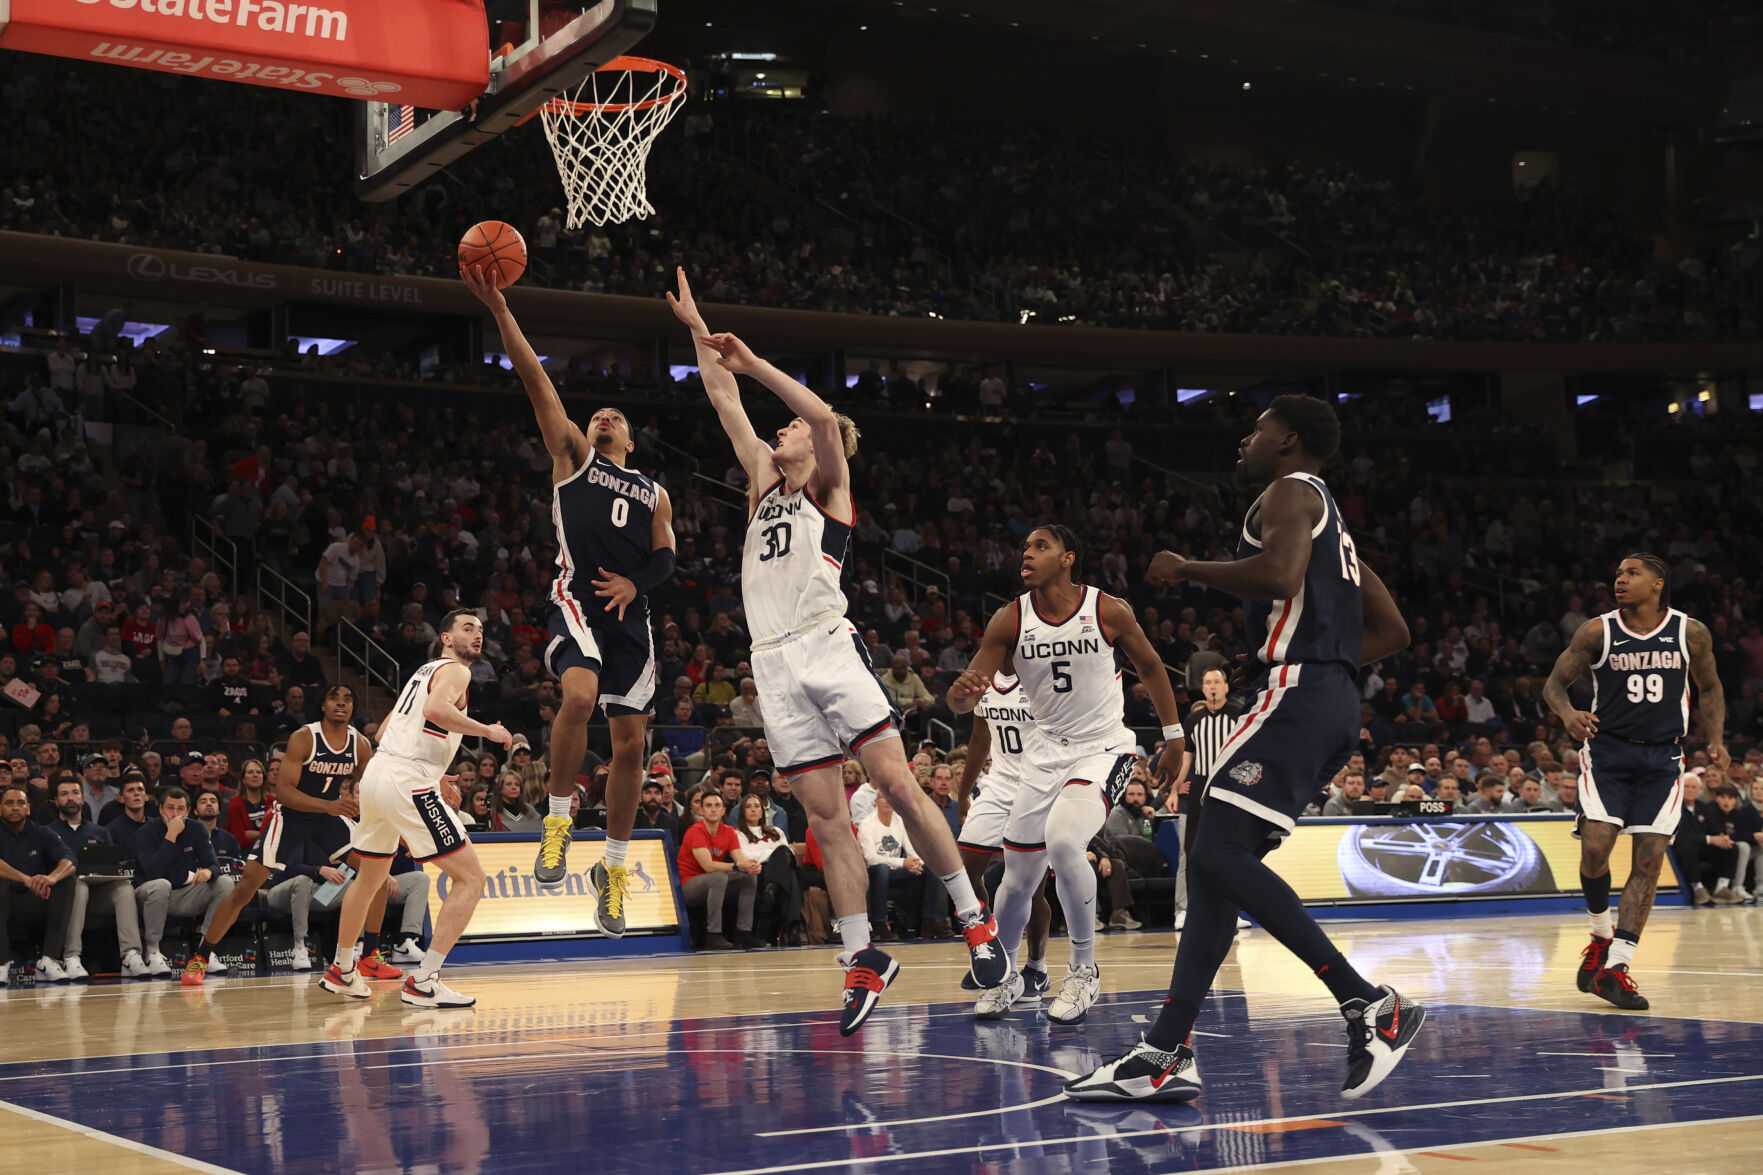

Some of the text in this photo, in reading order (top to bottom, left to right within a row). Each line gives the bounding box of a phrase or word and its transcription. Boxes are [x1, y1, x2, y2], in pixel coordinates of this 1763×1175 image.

[169, 263, 277, 289] LEXUS
[311, 278, 423, 303] SUITE LEVEL
[587, 466, 656, 512] GONZAGA
[611, 497, 630, 528] 0
[760, 522, 792, 562] 30
[1336, 520, 1361, 587] 13
[1021, 638, 1099, 660] UCONN
[1608, 650, 1682, 671] GONZAGA
[223, 686, 248, 697] ZAGS
[1051, 660, 1073, 693] 5
[1626, 673, 1664, 704] 99
[398, 679, 421, 715] 11
[996, 725, 1024, 755] 10
[321, 776, 334, 794] 1
[420, 794, 455, 847] HUSKIES
[1420, 801, 1445, 813] POSS
